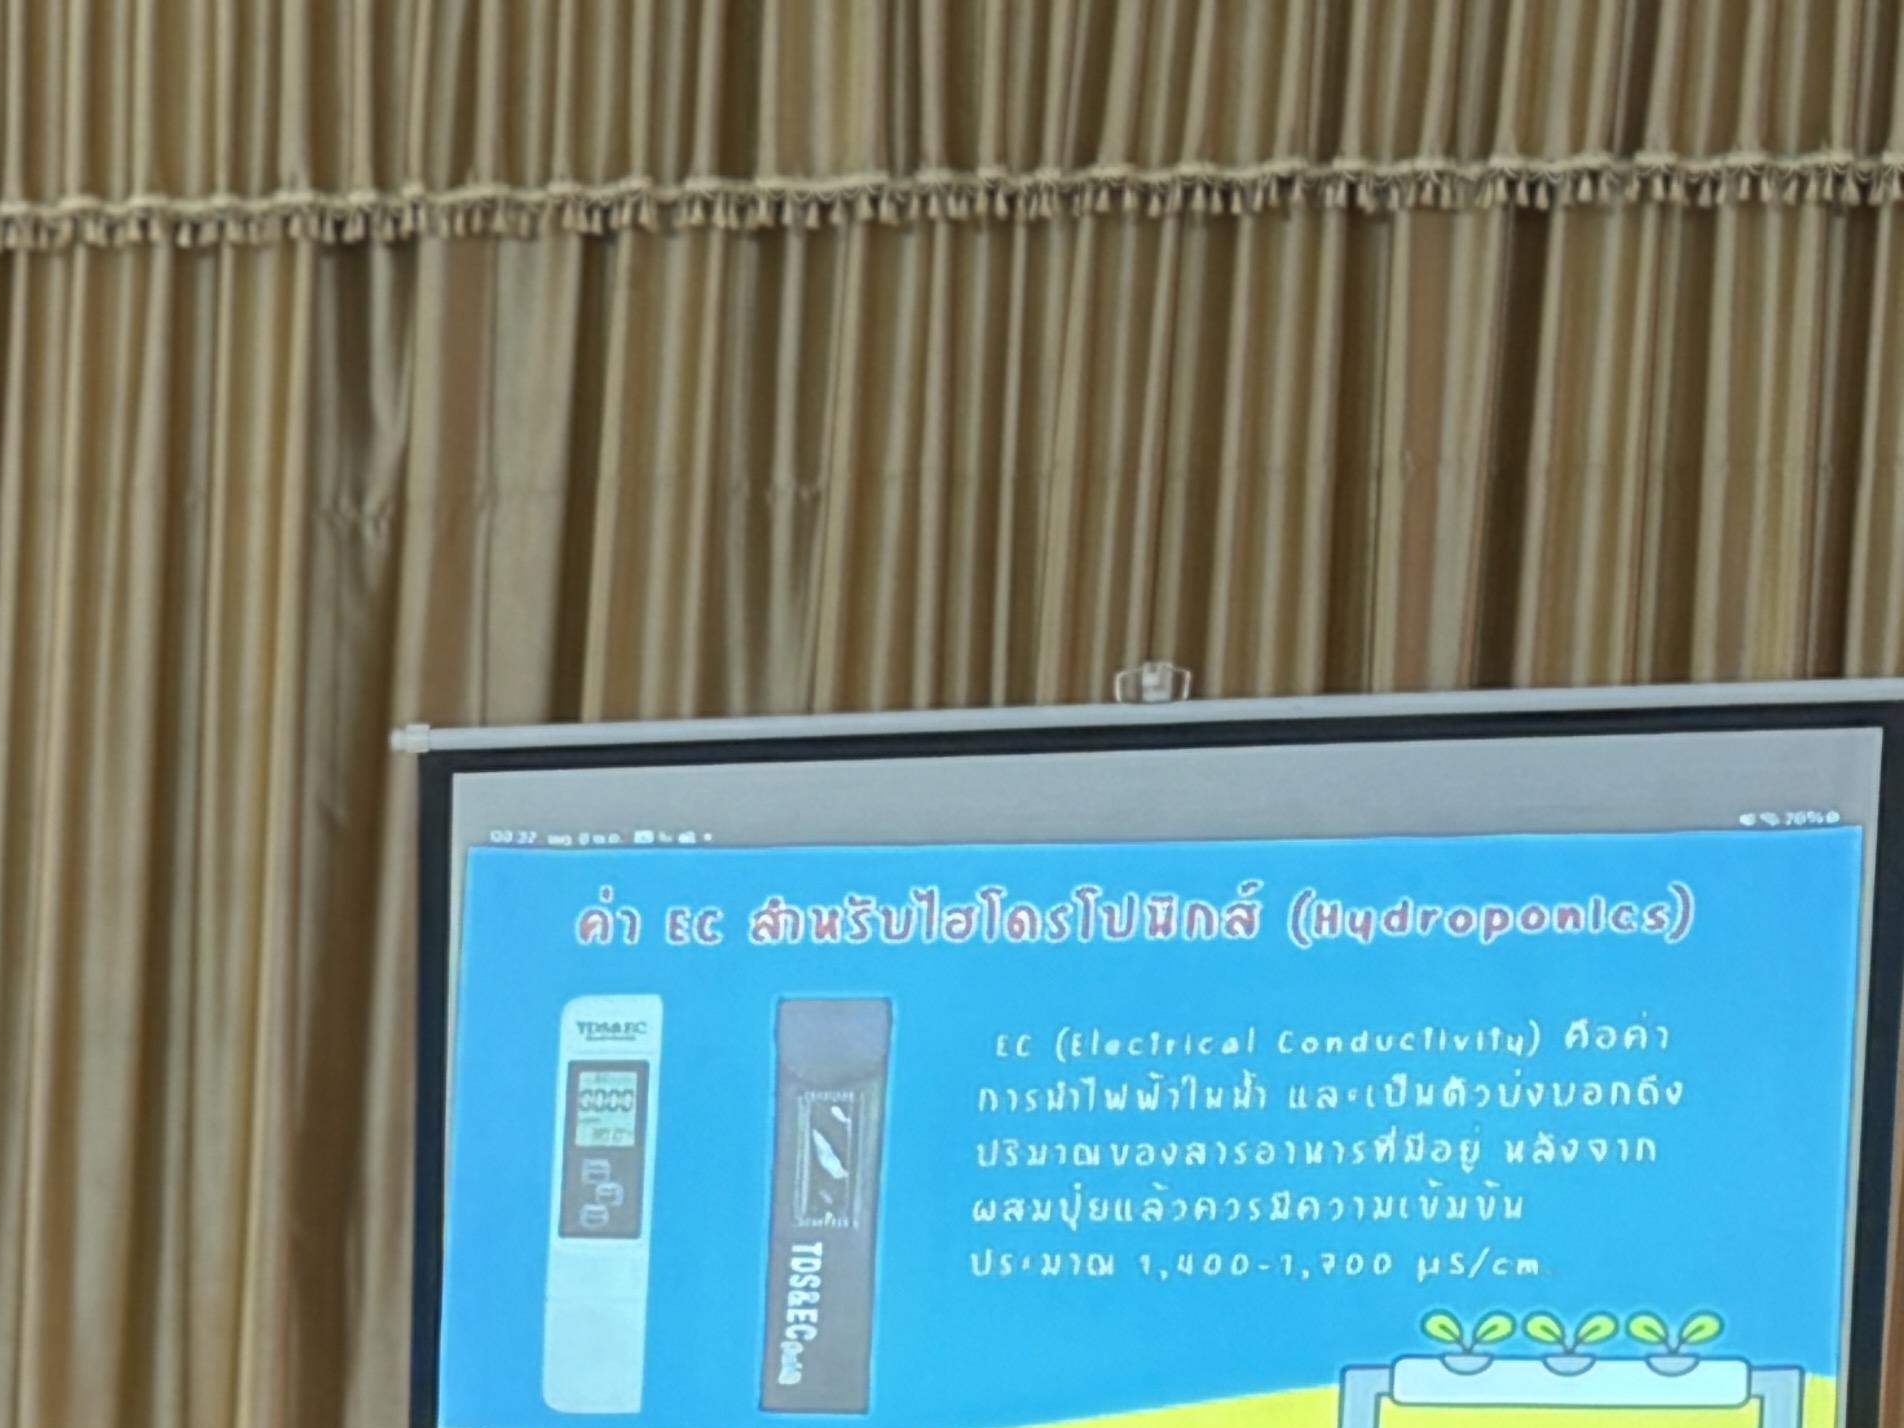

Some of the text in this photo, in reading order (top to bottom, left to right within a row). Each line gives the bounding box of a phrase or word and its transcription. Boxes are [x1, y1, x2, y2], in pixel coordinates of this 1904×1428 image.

[575, 880, 1696, 948] ค่า EC สำหรับไฮโดรโปนิกส์ (Hydroponics)
[995, 1011, 1670, 1064] EC (Electrical Conductivity) คือค่า
[976, 1067, 1684, 1112] การนำไฟฟ้าในน้ำ และเป็นตัวบ่งบอกถึง
[976, 1125, 1658, 1173] ปริมาณของสารอาหารที่มีอยู่ หลังจาก
[970, 1248, 1115, 1277] ประมาณ
[1139, 1252, 1393, 1281] 1,400-1,700
[785, 1241, 823, 1341] TDS&EC
